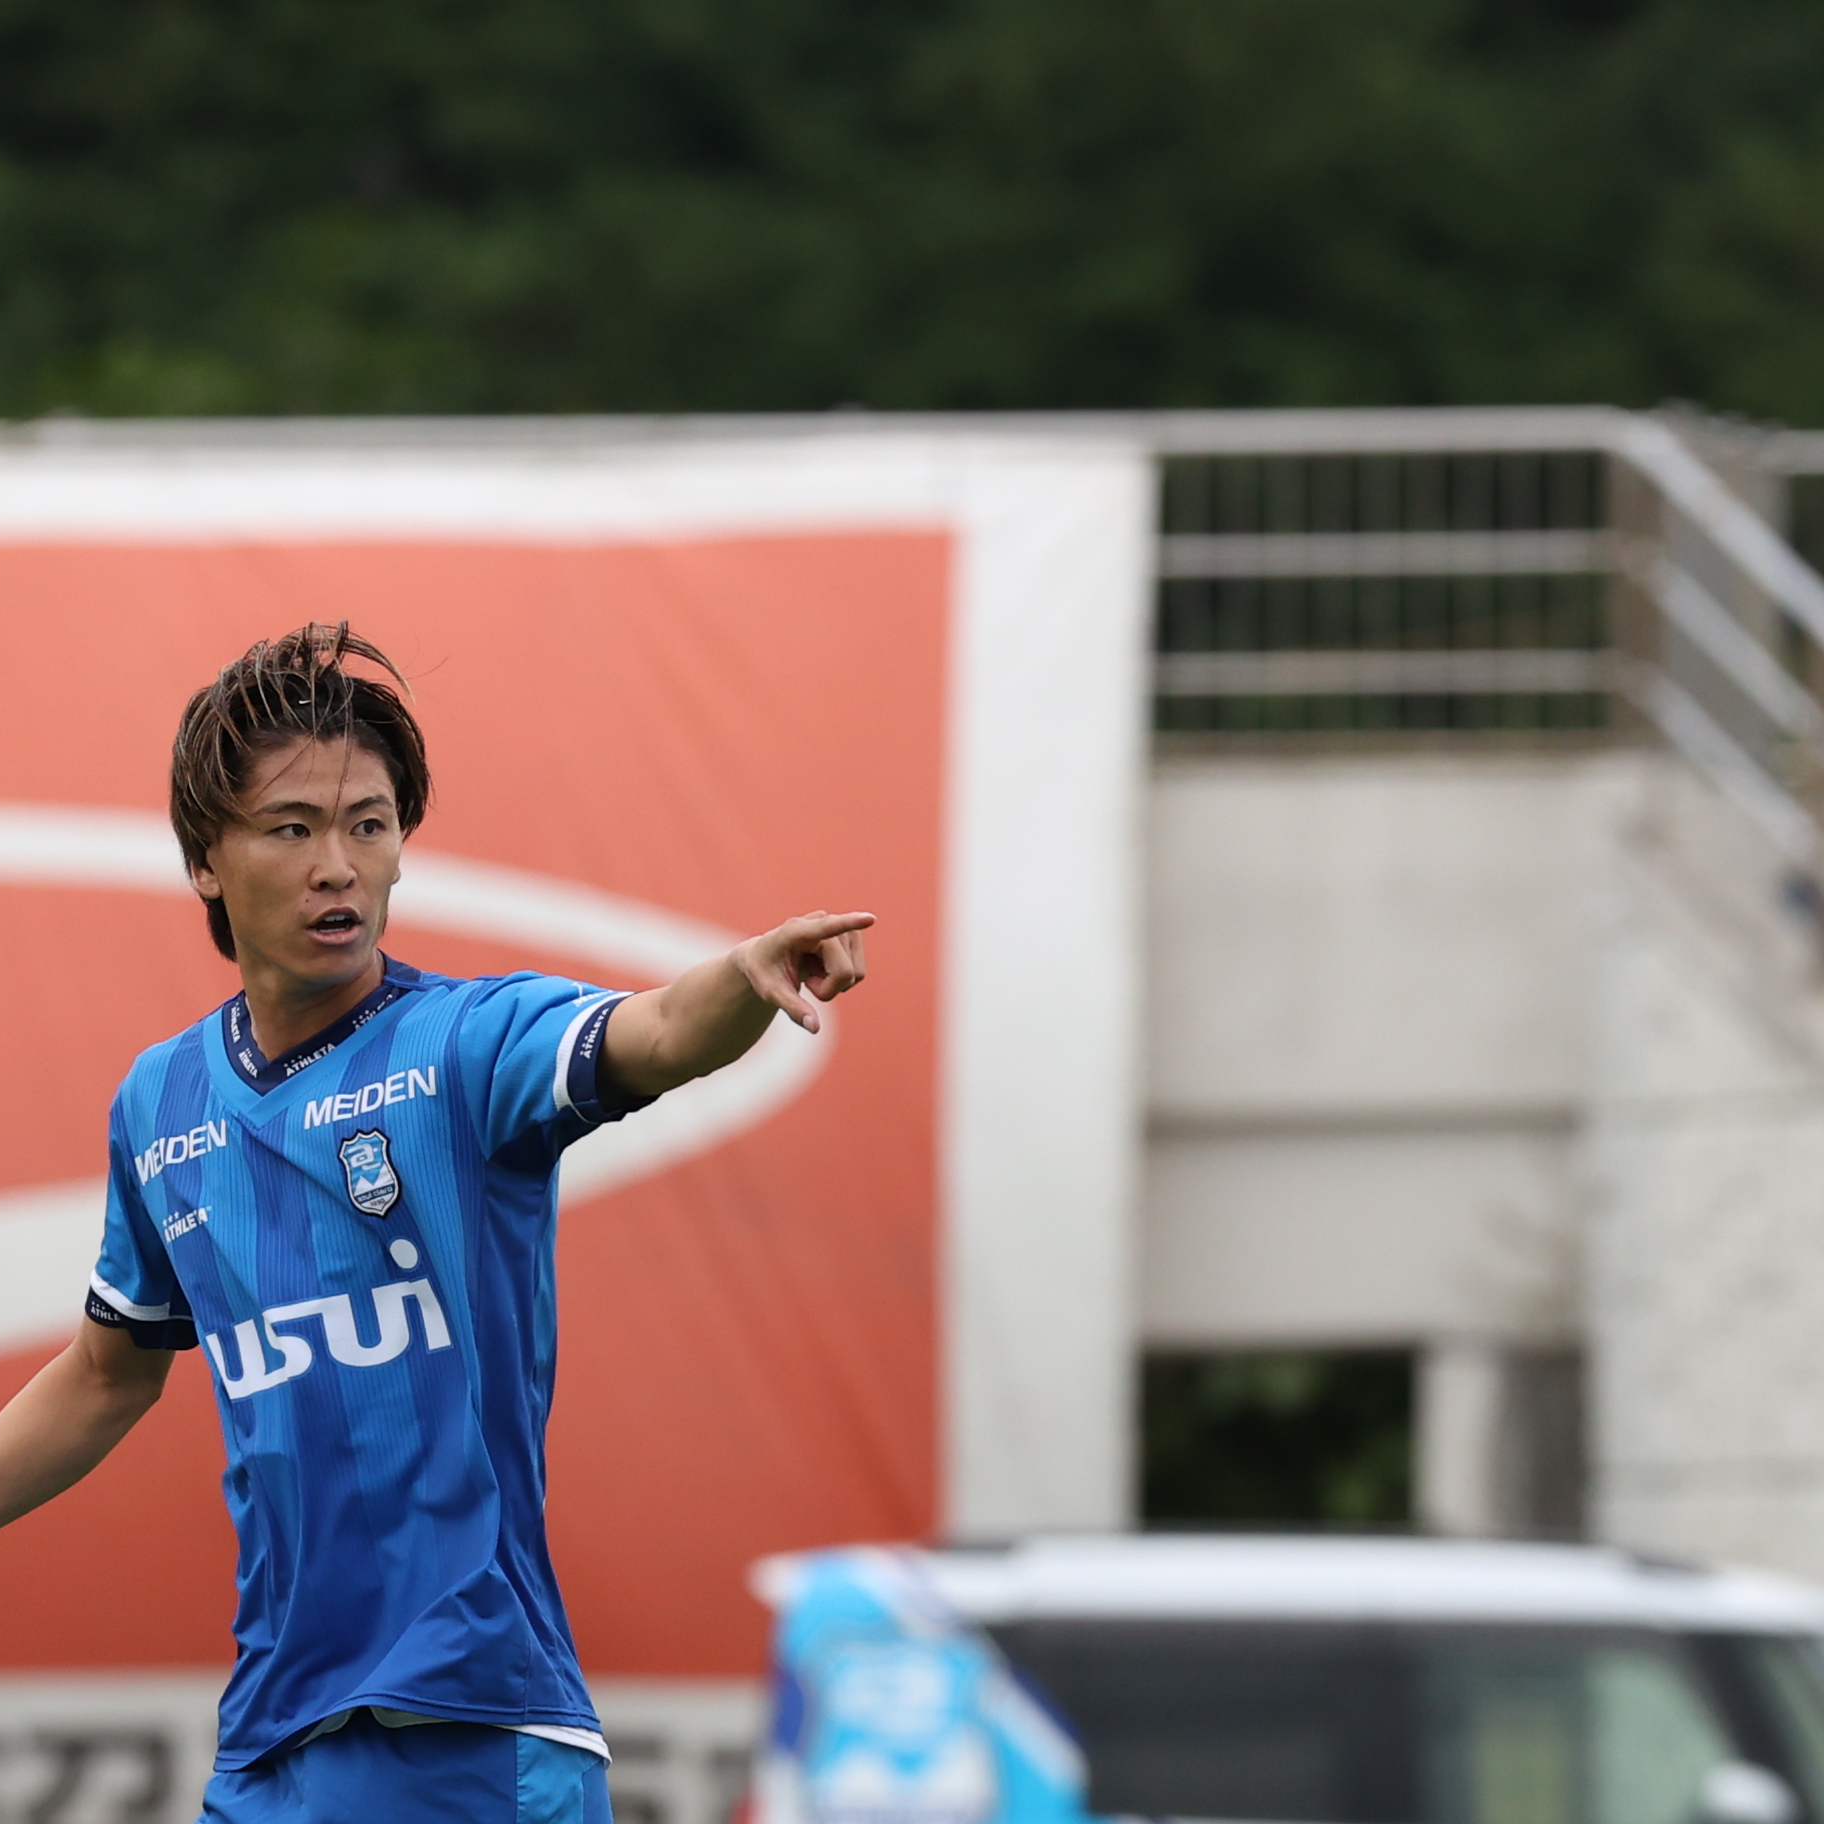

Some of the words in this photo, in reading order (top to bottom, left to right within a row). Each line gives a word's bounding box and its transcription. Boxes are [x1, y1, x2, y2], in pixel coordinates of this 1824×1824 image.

[583, 1008, 610, 1059] ATHLETA
[238, 1050, 258, 1079] ATHLETA
[286, 1043, 337, 1077] ATHLETA
[304, 1066, 437, 1130] MEIDEN
[134, 1118, 227, 1186] MEIDEN
[164, 1207, 209, 1244] ATHLETA
[206, 1238, 452, 1400] usui
